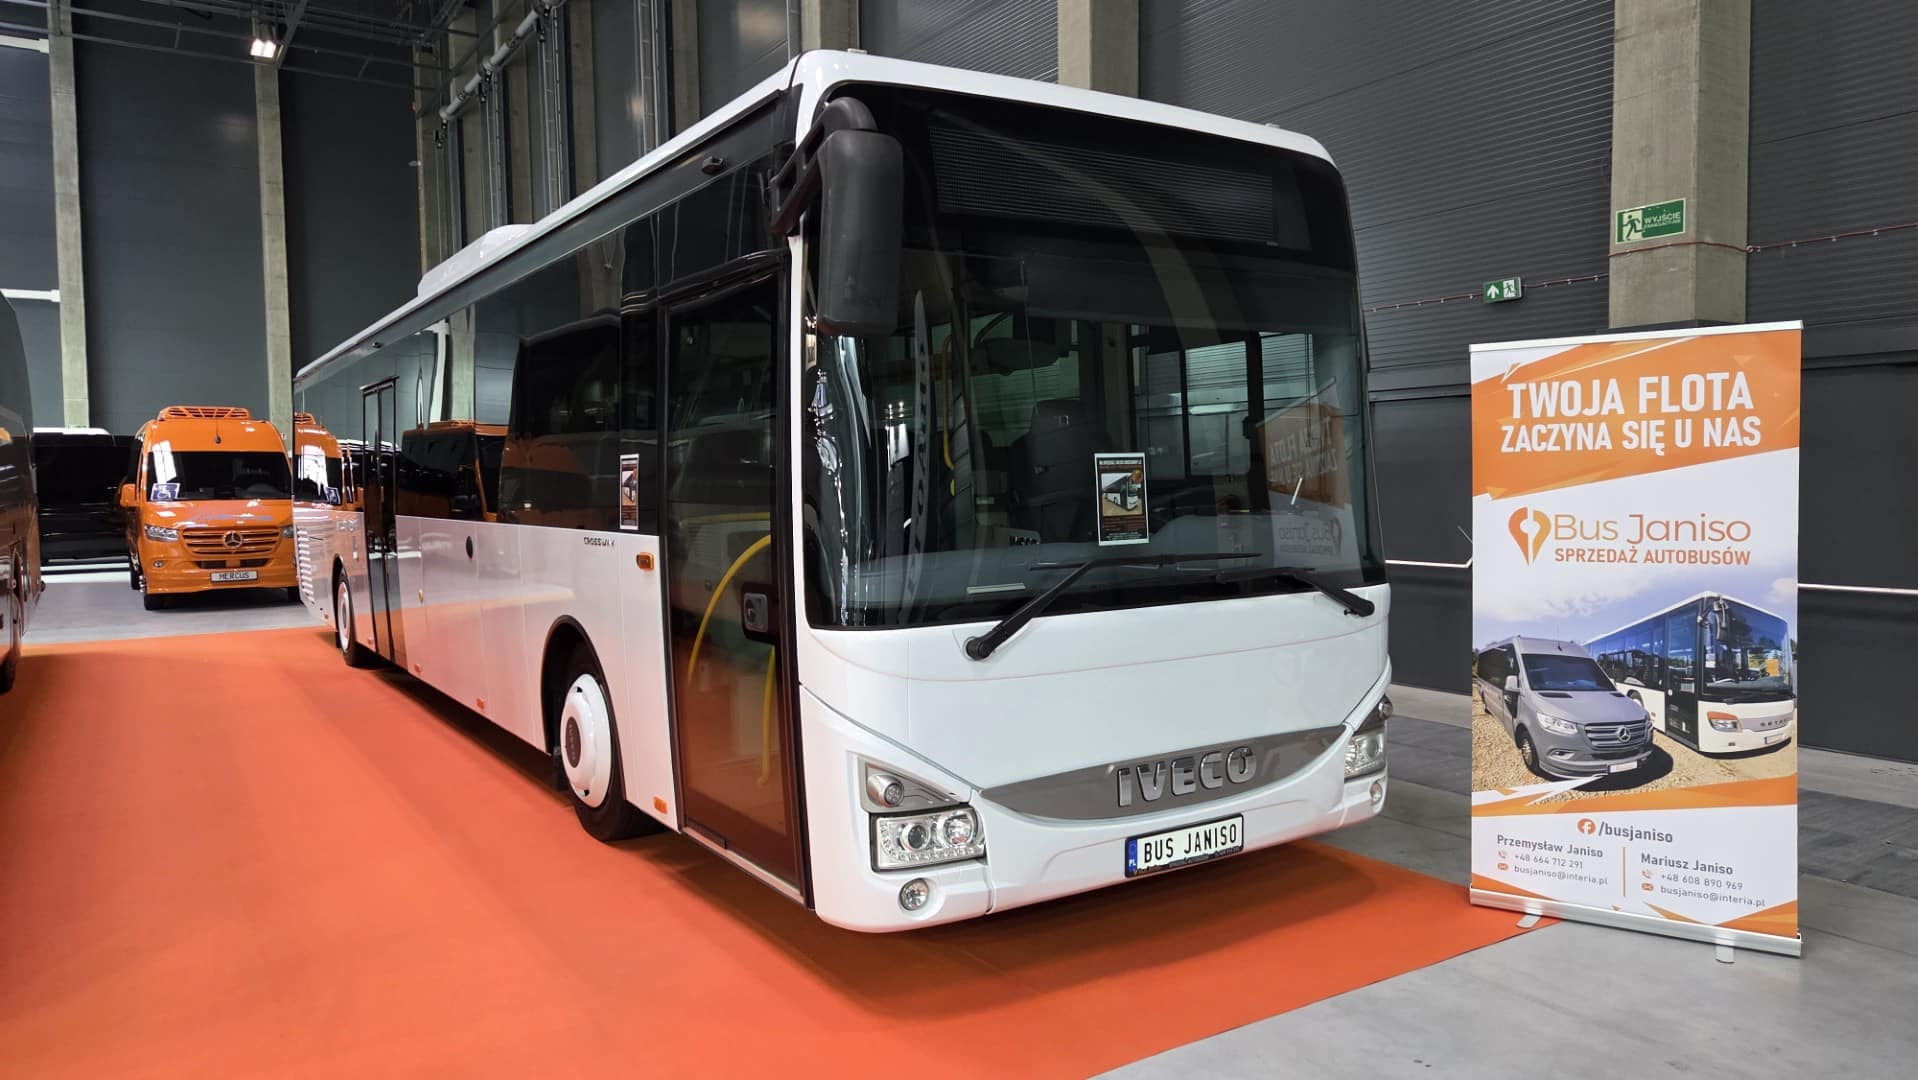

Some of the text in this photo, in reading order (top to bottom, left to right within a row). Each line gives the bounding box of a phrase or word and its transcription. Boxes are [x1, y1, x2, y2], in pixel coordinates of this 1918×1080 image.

[1507, 371, 1754, 419] TWOJA FLOTA
[1501, 416, 1761, 456] ZACZYNA SIĘ U NAS
[1554, 512, 1752, 545] Bus Janiso
[1554, 545, 1751, 566] SPRZEDAŻ AUTOBUSÓW
[1117, 747, 1257, 807] IVECO
[1598, 821, 1673, 843] /busjaniso
[1144, 838, 1174, 864] BUS
[1183, 823, 1237, 854] JANISO
[1497, 834, 1603, 858] Przemysław Janiso
[1128, 858, 1138, 867] PL
[1514, 853, 1583, 869] +48 664 712 291
[1641, 853, 1734, 875] Mariusz Janiso
[1514, 864, 1608, 885] busjaniso@interia.pl
[1660, 873, 1743, 891] +48 608 890 969
[1660, 885, 1766, 908] busjaniso@interia.pl
